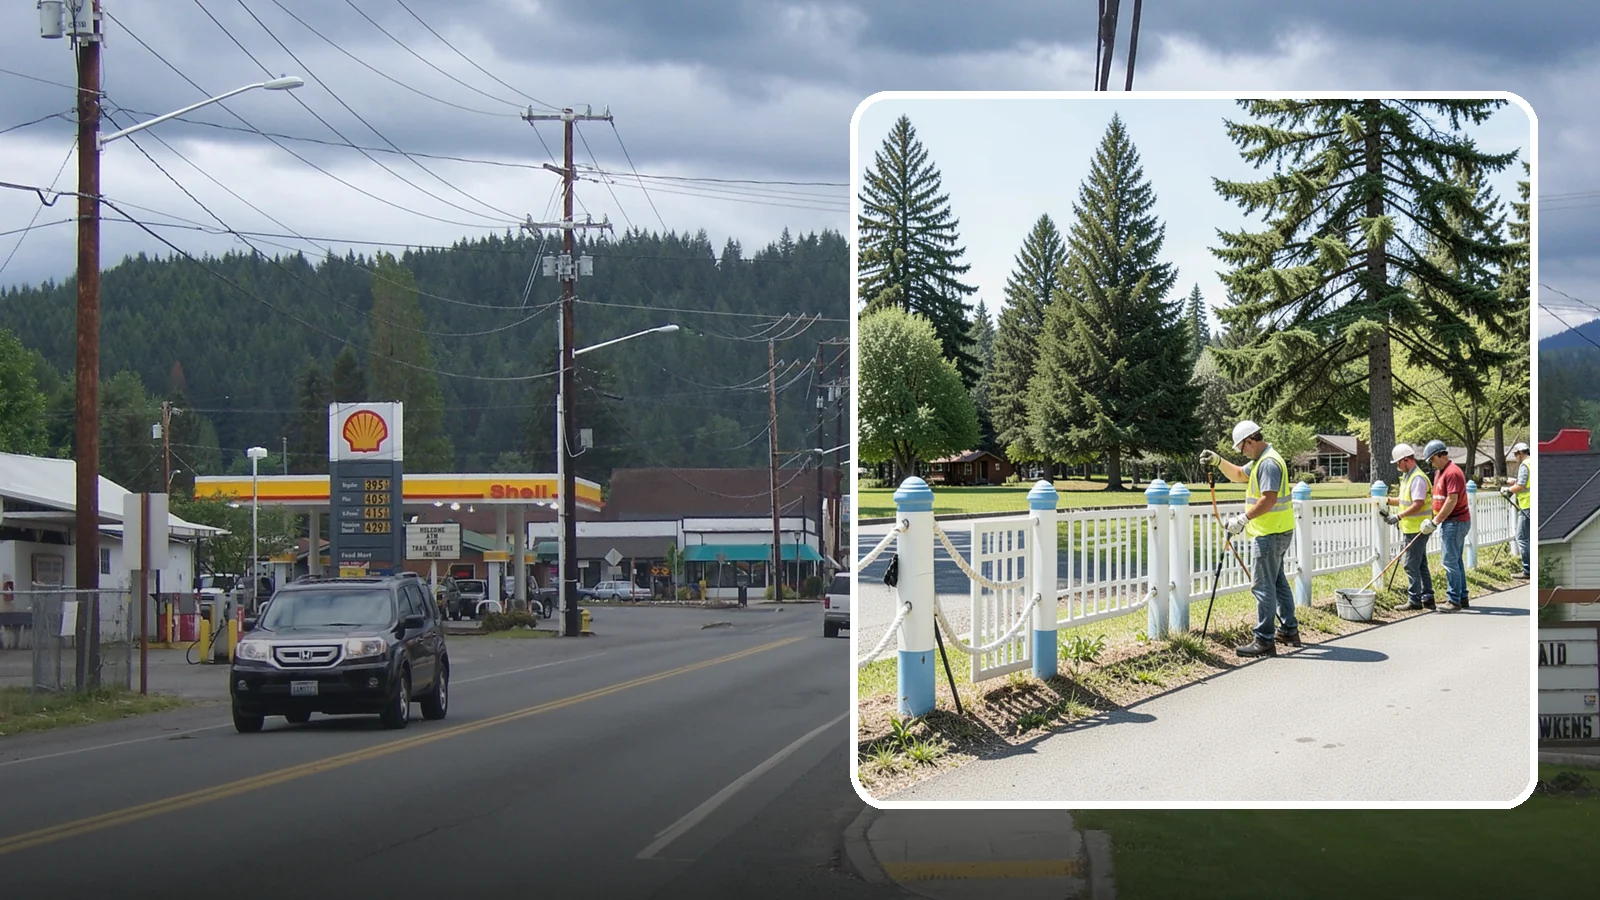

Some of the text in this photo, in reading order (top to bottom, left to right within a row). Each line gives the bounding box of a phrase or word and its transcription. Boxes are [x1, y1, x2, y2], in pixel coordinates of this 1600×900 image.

[365, 480, 384, 490] 395
[490, 484, 547, 499] Shell
[365, 494, 384, 504] 405
[365, 508, 384, 518] 415
[365, 522, 384, 533] 429
